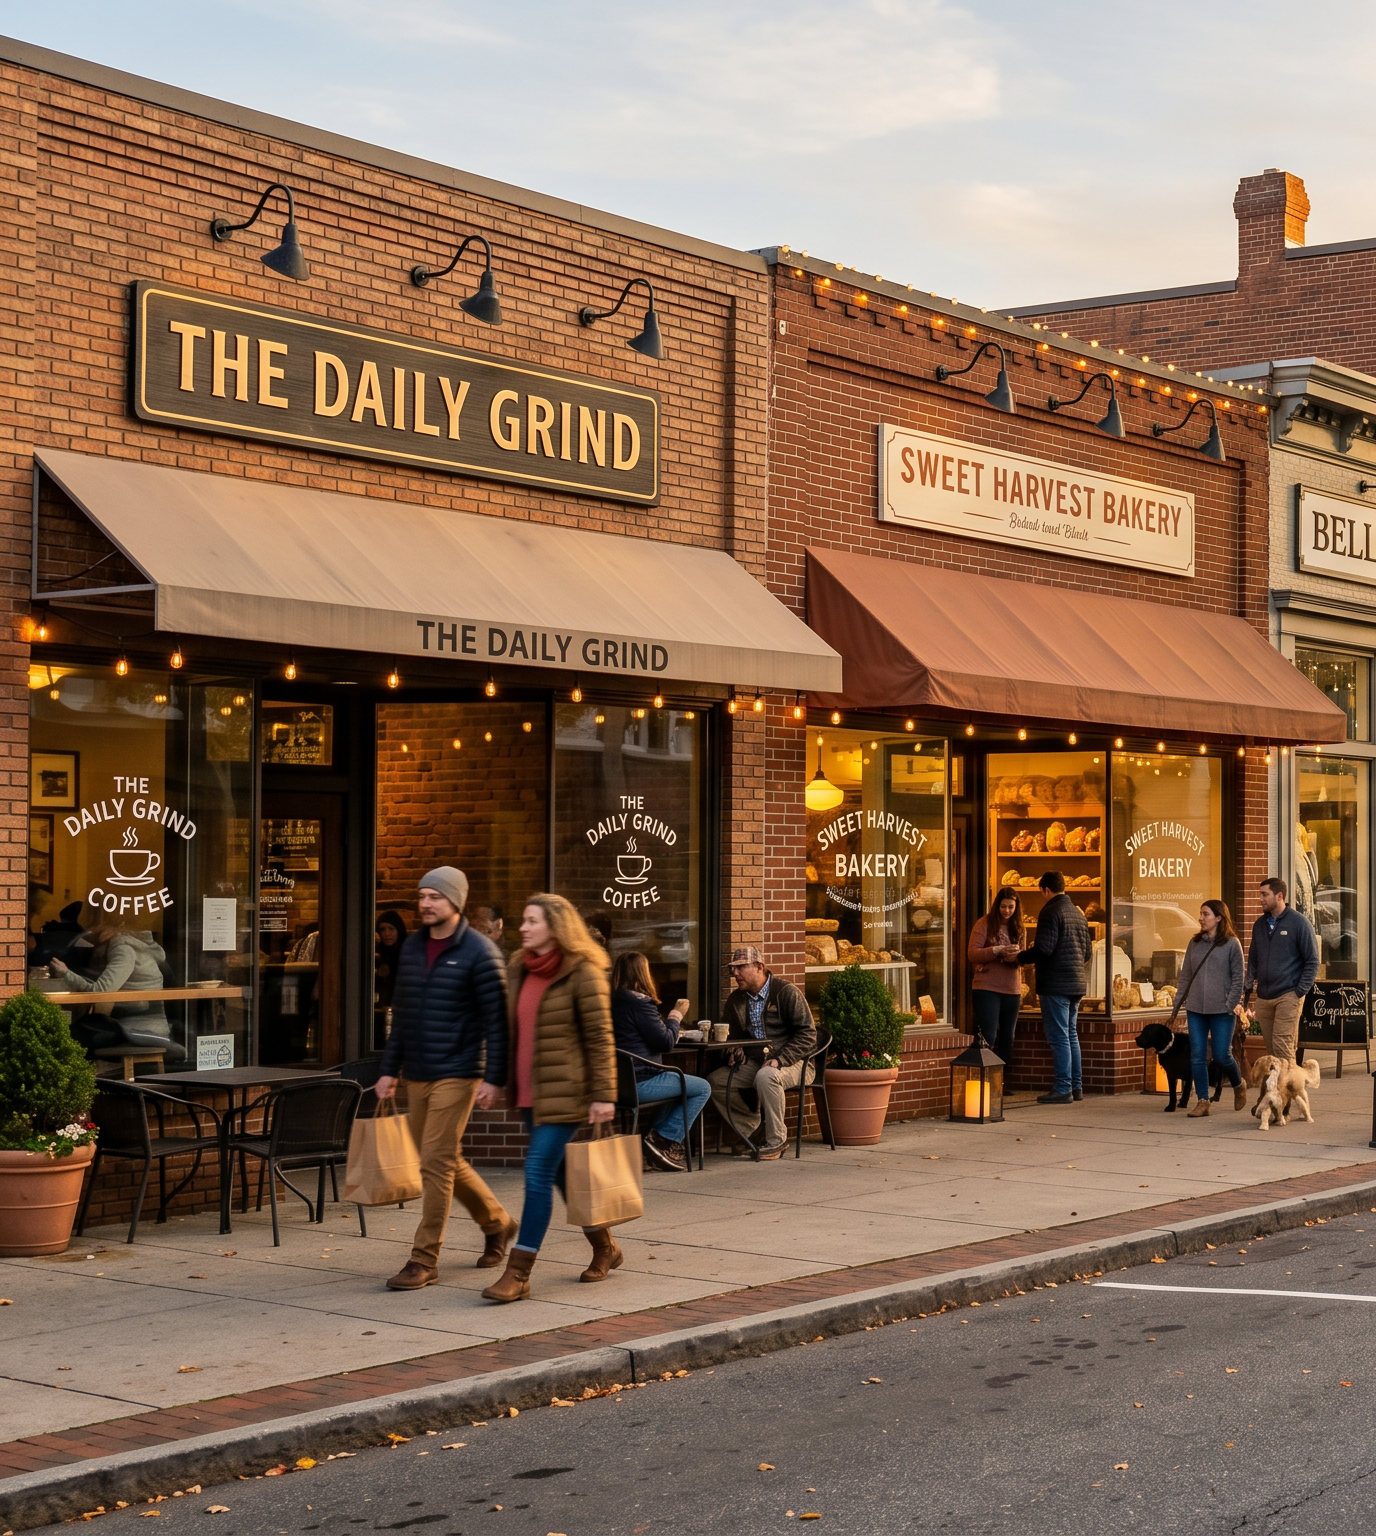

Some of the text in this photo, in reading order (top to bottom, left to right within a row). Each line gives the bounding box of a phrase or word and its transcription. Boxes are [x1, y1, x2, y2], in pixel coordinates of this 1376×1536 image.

[170, 320, 641, 472] THE DAILY GRIND
[900, 446, 1182, 537] SWEET HARVEST BAKERY
[417, 620, 669, 672] THE DAILY GRIND
[113, 776, 149, 795] THE
[620, 795, 645, 810] THE
[63, 798, 197, 841] DAILY GRIND
[585, 813, 677, 846] DAILY GRIND
[817, 810, 928, 852] SWEET HARVEST
[1125, 821, 1205, 857] SWEET HARVEST
[835, 853, 909, 877] BAKERY
[1138, 858, 1192, 878] BAKERY
[87, 887, 174, 915] COFFEE
[602, 885, 661, 909] COFFEE
